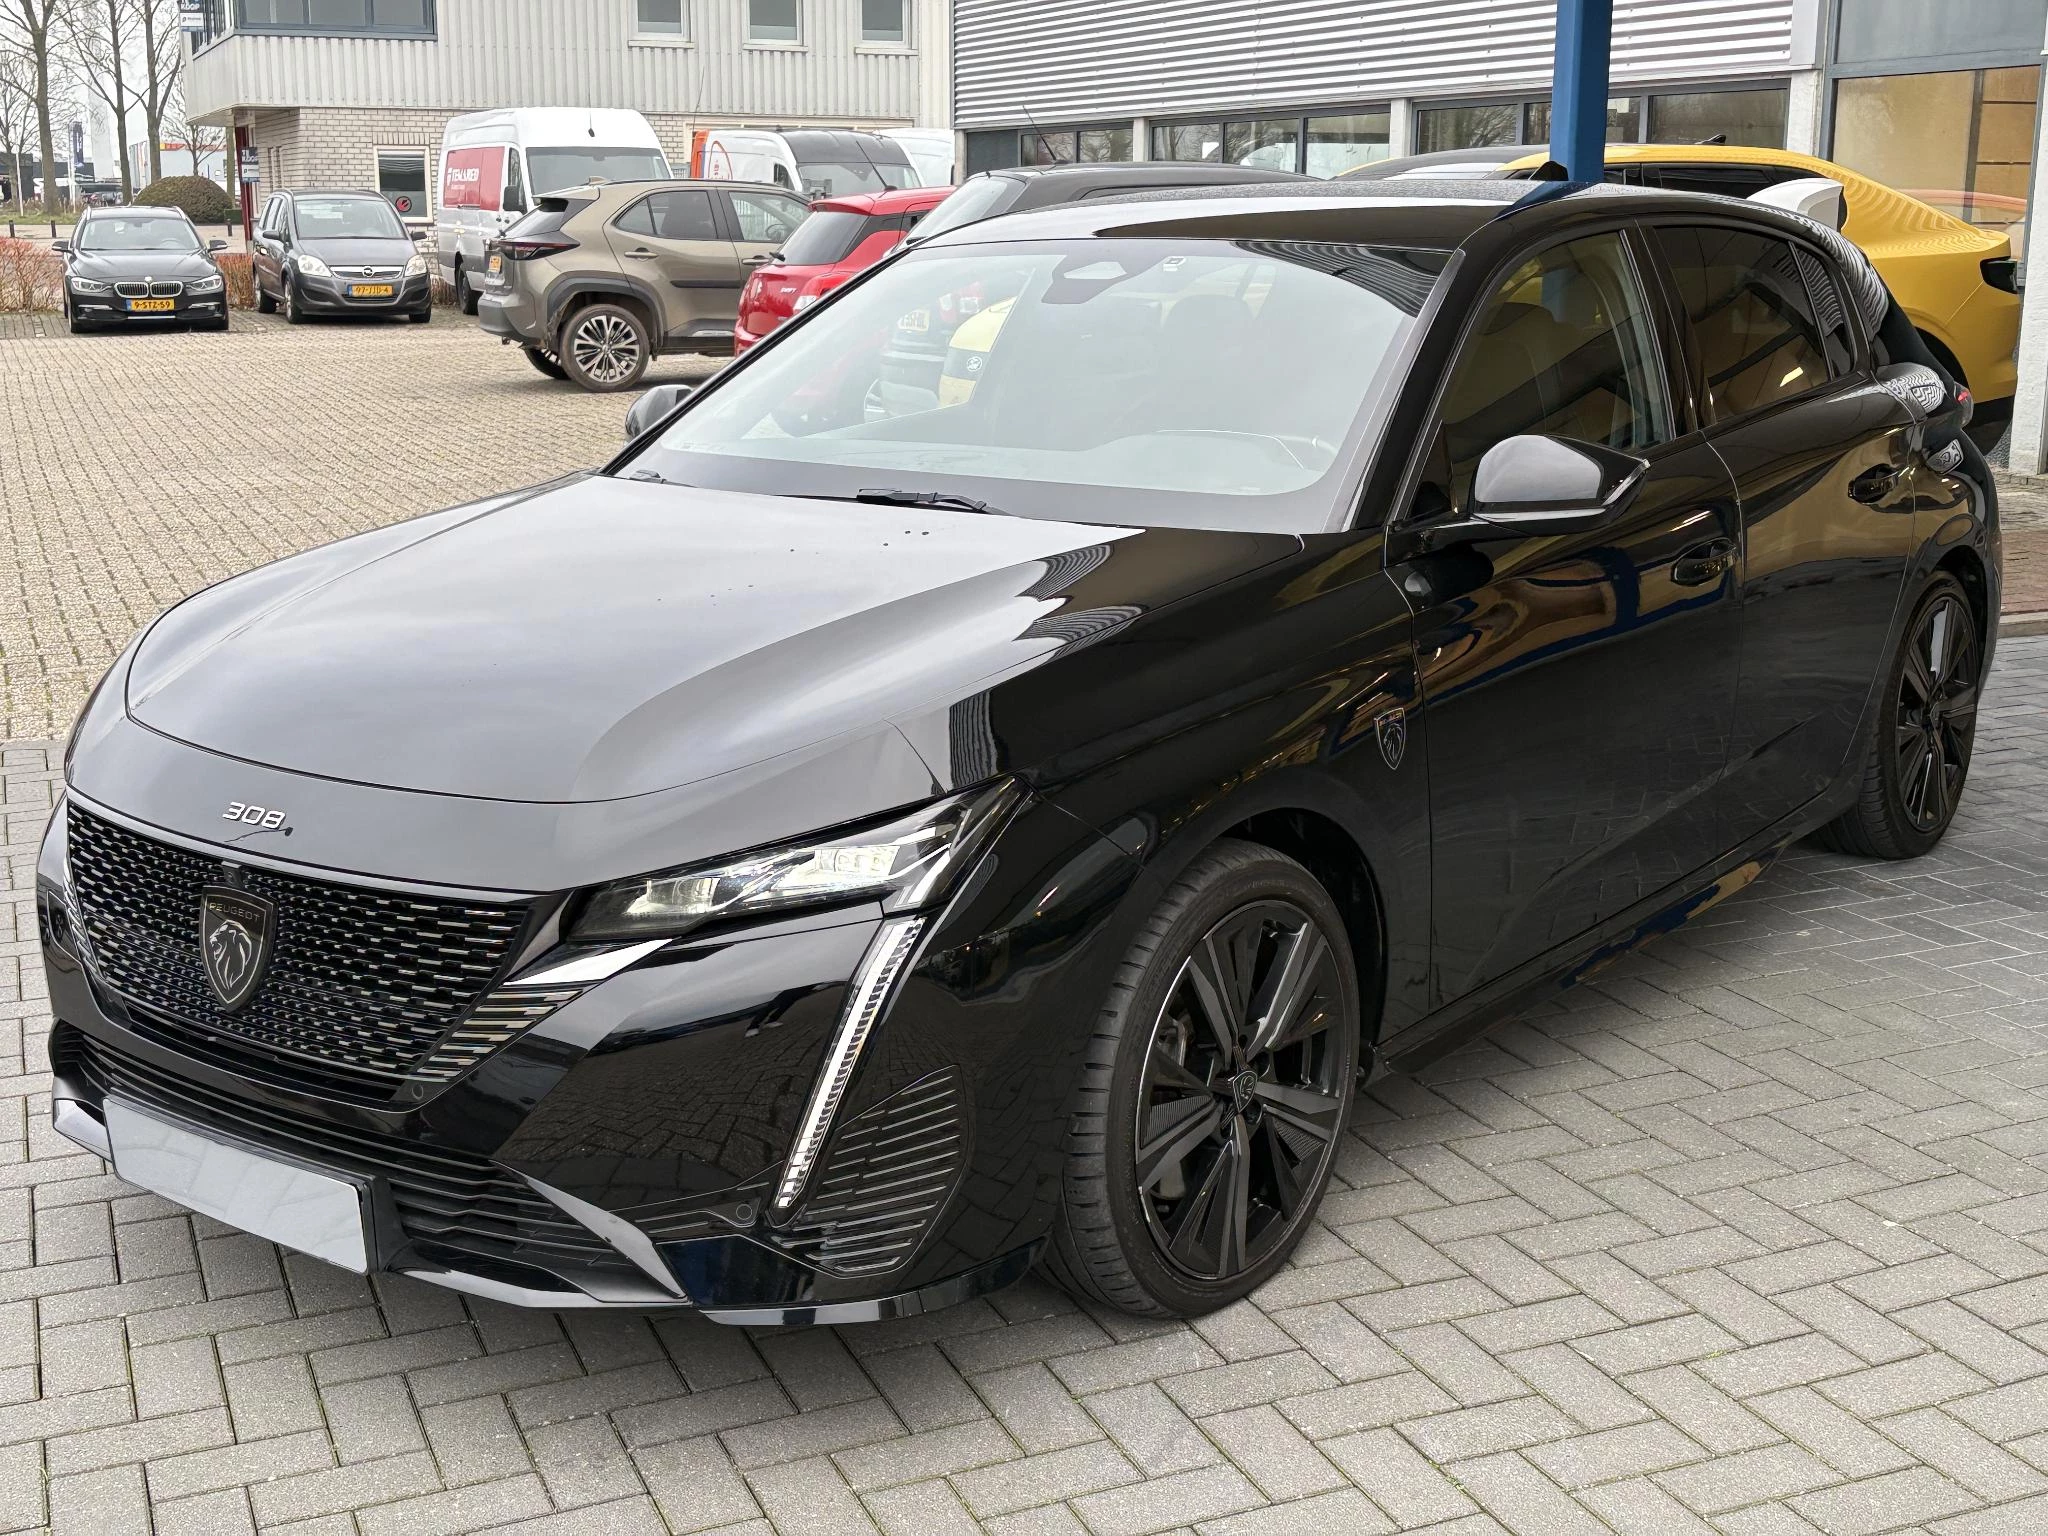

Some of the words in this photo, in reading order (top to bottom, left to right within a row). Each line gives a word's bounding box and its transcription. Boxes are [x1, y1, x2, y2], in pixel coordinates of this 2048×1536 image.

[134, 301, 171, 310] 9-STZ-59
[222, 801, 286, 830] 308
[209, 902, 260, 921] PEUGEOT
